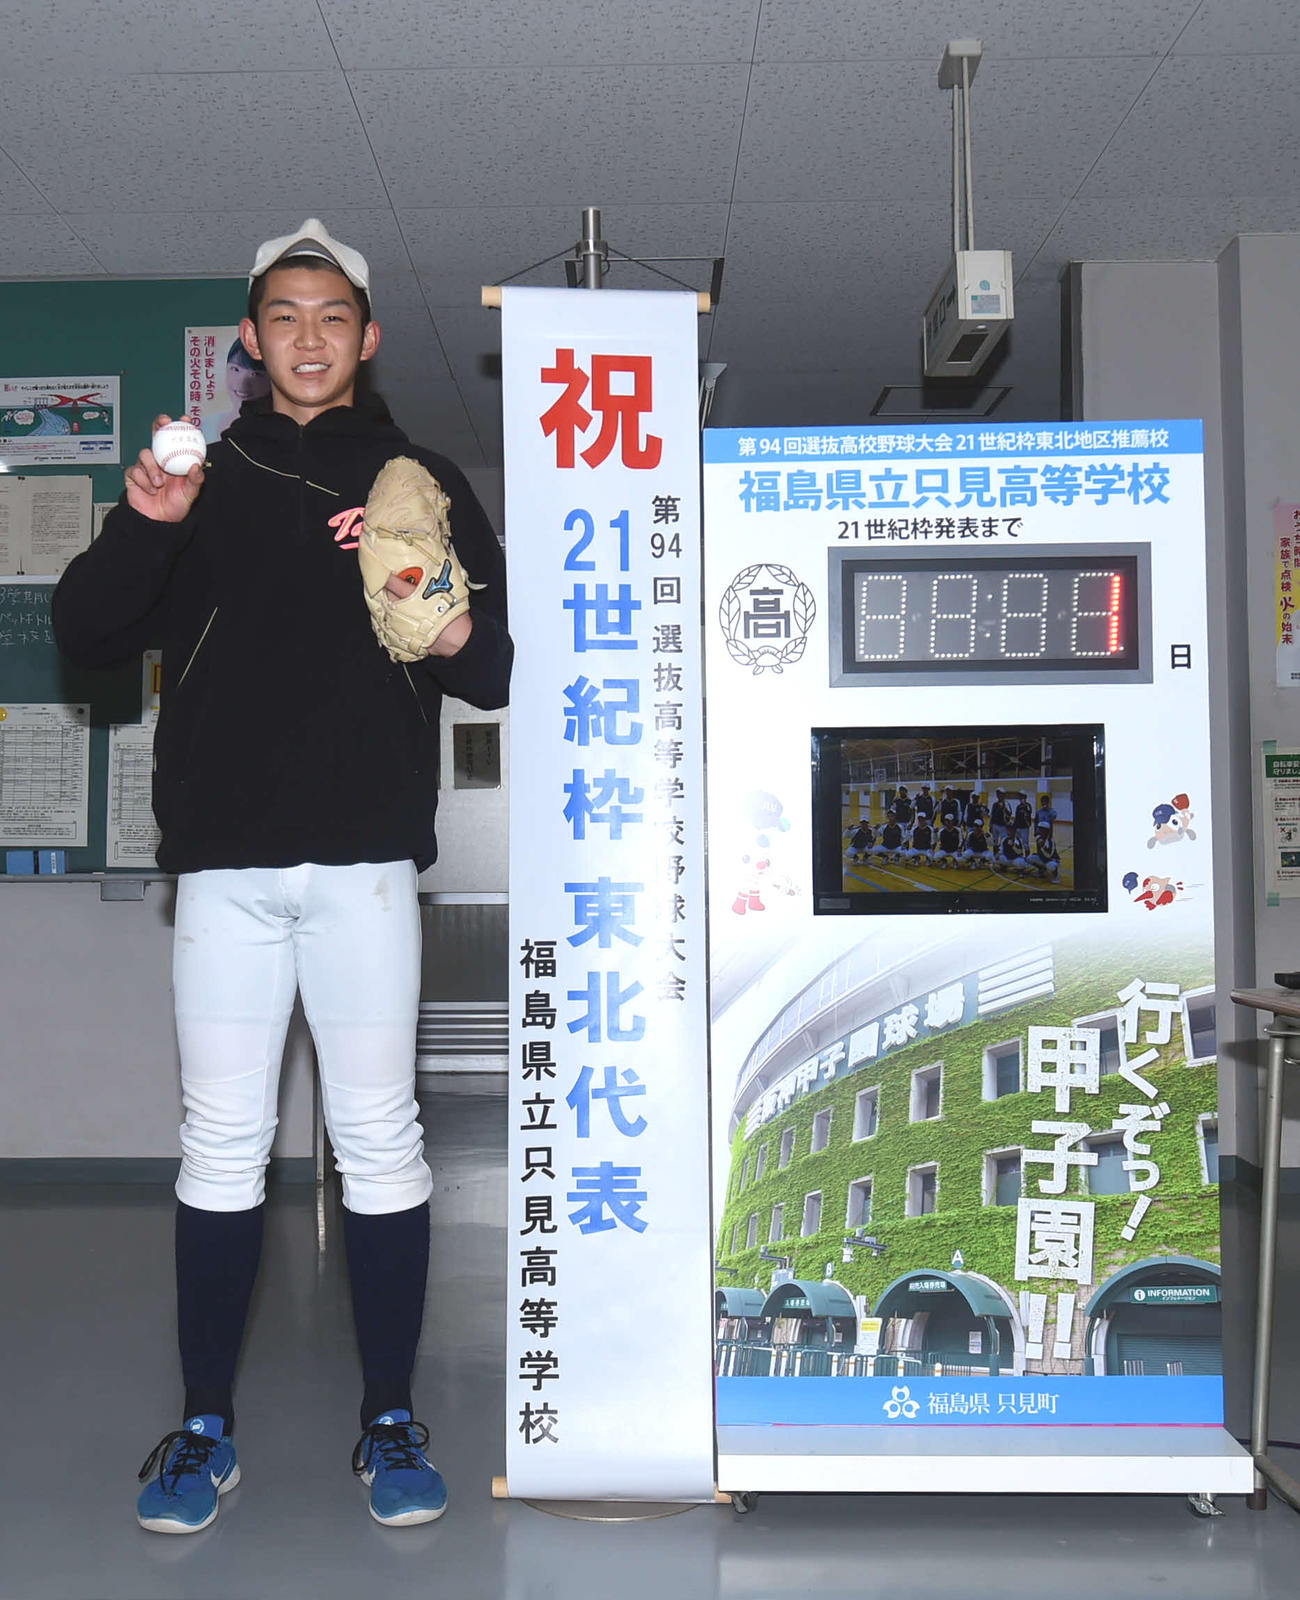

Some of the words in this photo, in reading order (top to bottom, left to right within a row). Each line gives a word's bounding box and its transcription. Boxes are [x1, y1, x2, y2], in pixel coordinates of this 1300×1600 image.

[204, 336, 215, 400] 消しましょう
[539, 348, 663, 470] 祝
[738, 462, 1171, 513] 福島県立只見高等学校
[837, 516, 1024, 541] 21世紀枠発表まで
[1171, 644, 1191, 668] 日
[518, 939, 559, 1444] 福島県立只見高等学校
[951, 1249, 964, 1265] A
[1147, 1288, 1210, 1297] INFORMATION
[928, 1392, 990, 1415] 福島県
[997, 1392, 1060, 1415] 只見町
